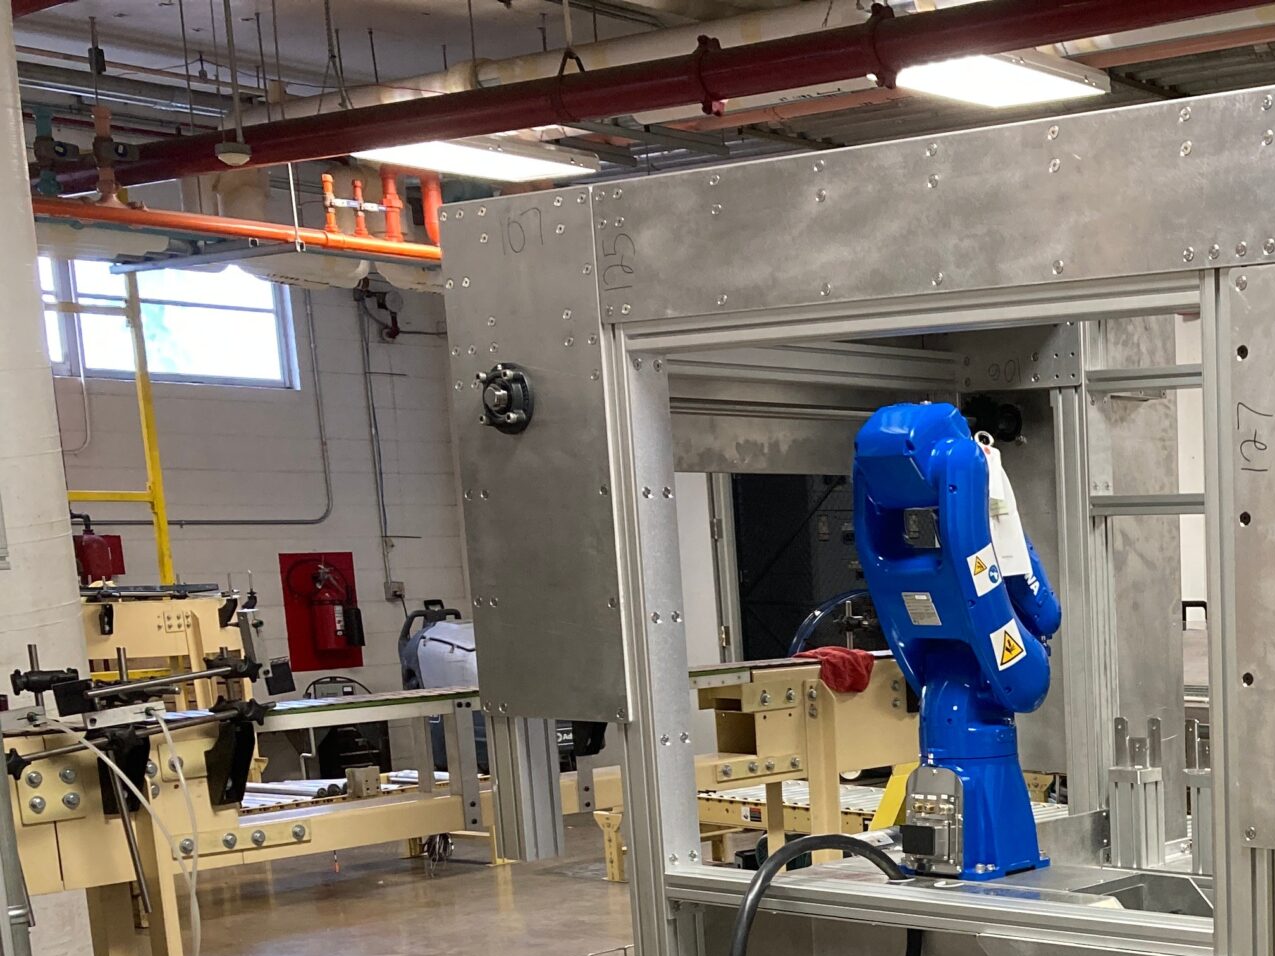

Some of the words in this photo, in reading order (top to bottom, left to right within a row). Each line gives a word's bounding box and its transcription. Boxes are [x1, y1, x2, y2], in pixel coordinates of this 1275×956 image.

[500, 206, 544, 256] 107
[602, 232, 636, 292] 125
[1236, 401, 1274, 473] 127
